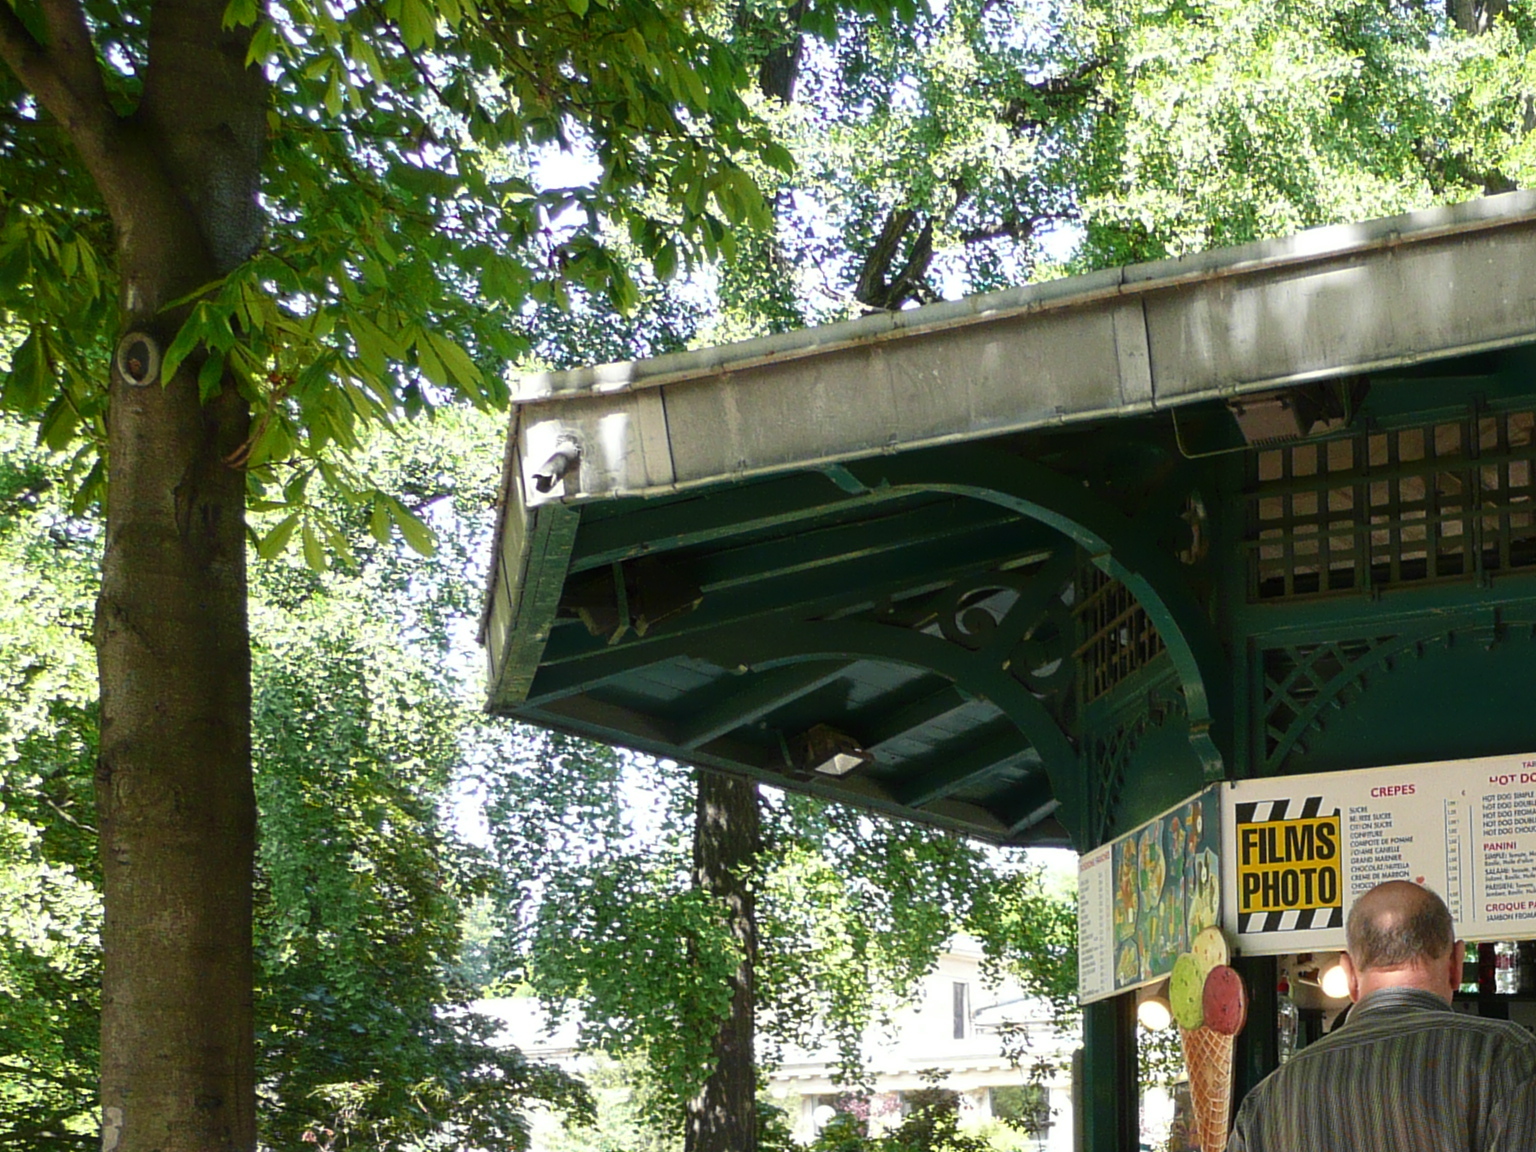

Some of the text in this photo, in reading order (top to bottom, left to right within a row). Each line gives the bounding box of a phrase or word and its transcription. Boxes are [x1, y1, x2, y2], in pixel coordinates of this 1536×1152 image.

[1489, 775, 1517, 785] HOT
[1371, 784, 1415, 797] CREPES
[1514, 791, 1534, 799] SIMPLE
[1514, 800, 1536, 808] DOUBLE
[1498, 810, 1512, 818] DOG
[1483, 820, 1496, 828] HOT
[1483, 828, 1496, 836] HOT
[1498, 827, 1513, 835] DOG
[1241, 822, 1336, 866] FILMS
[1484, 841, 1516, 851] PANINI
[1242, 866, 1337, 909] PHOTO
[1486, 902, 1526, 912] CROQUE
